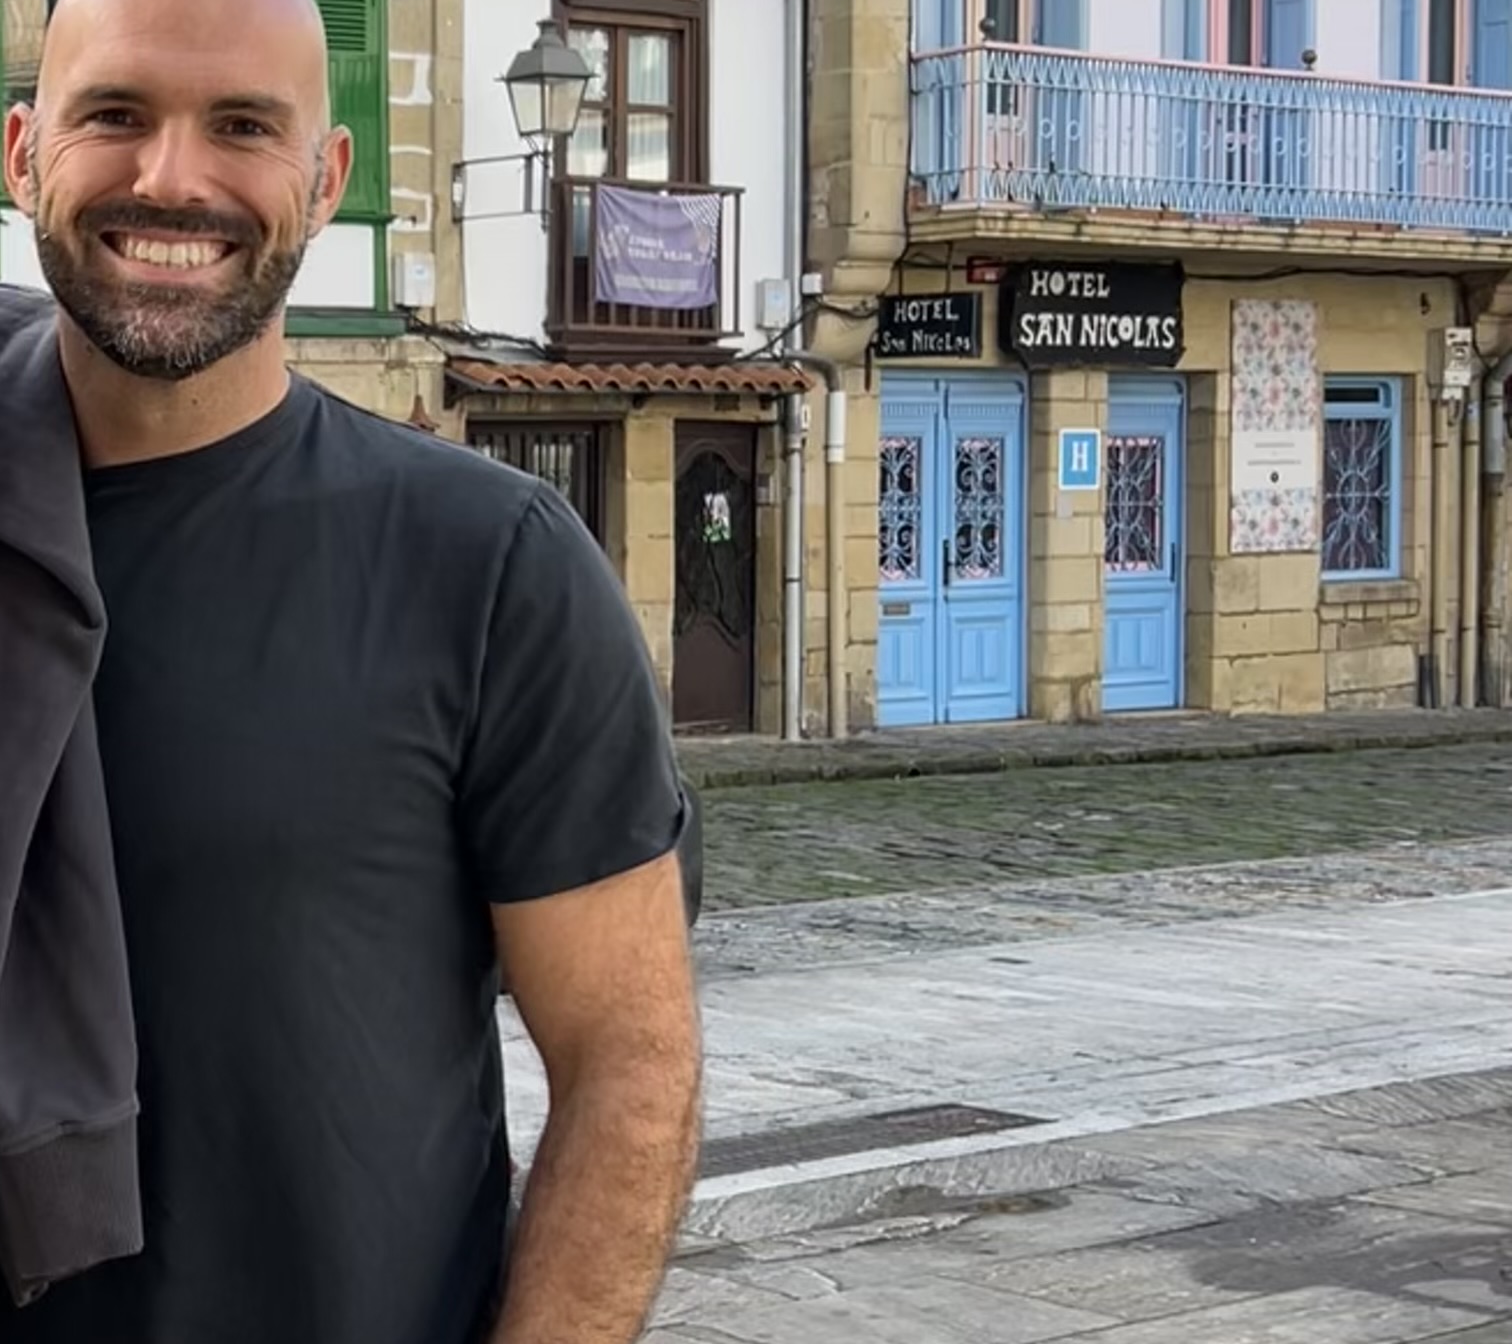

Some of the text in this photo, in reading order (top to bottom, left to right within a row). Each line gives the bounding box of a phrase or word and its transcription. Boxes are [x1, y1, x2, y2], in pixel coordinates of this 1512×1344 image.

[1030, 270, 1110, 297] HOTEL
[893, 299, 960, 323] HOTEL
[1019, 312, 1176, 349] SAN NICOLAS
[1071, 440, 1089, 472] H
